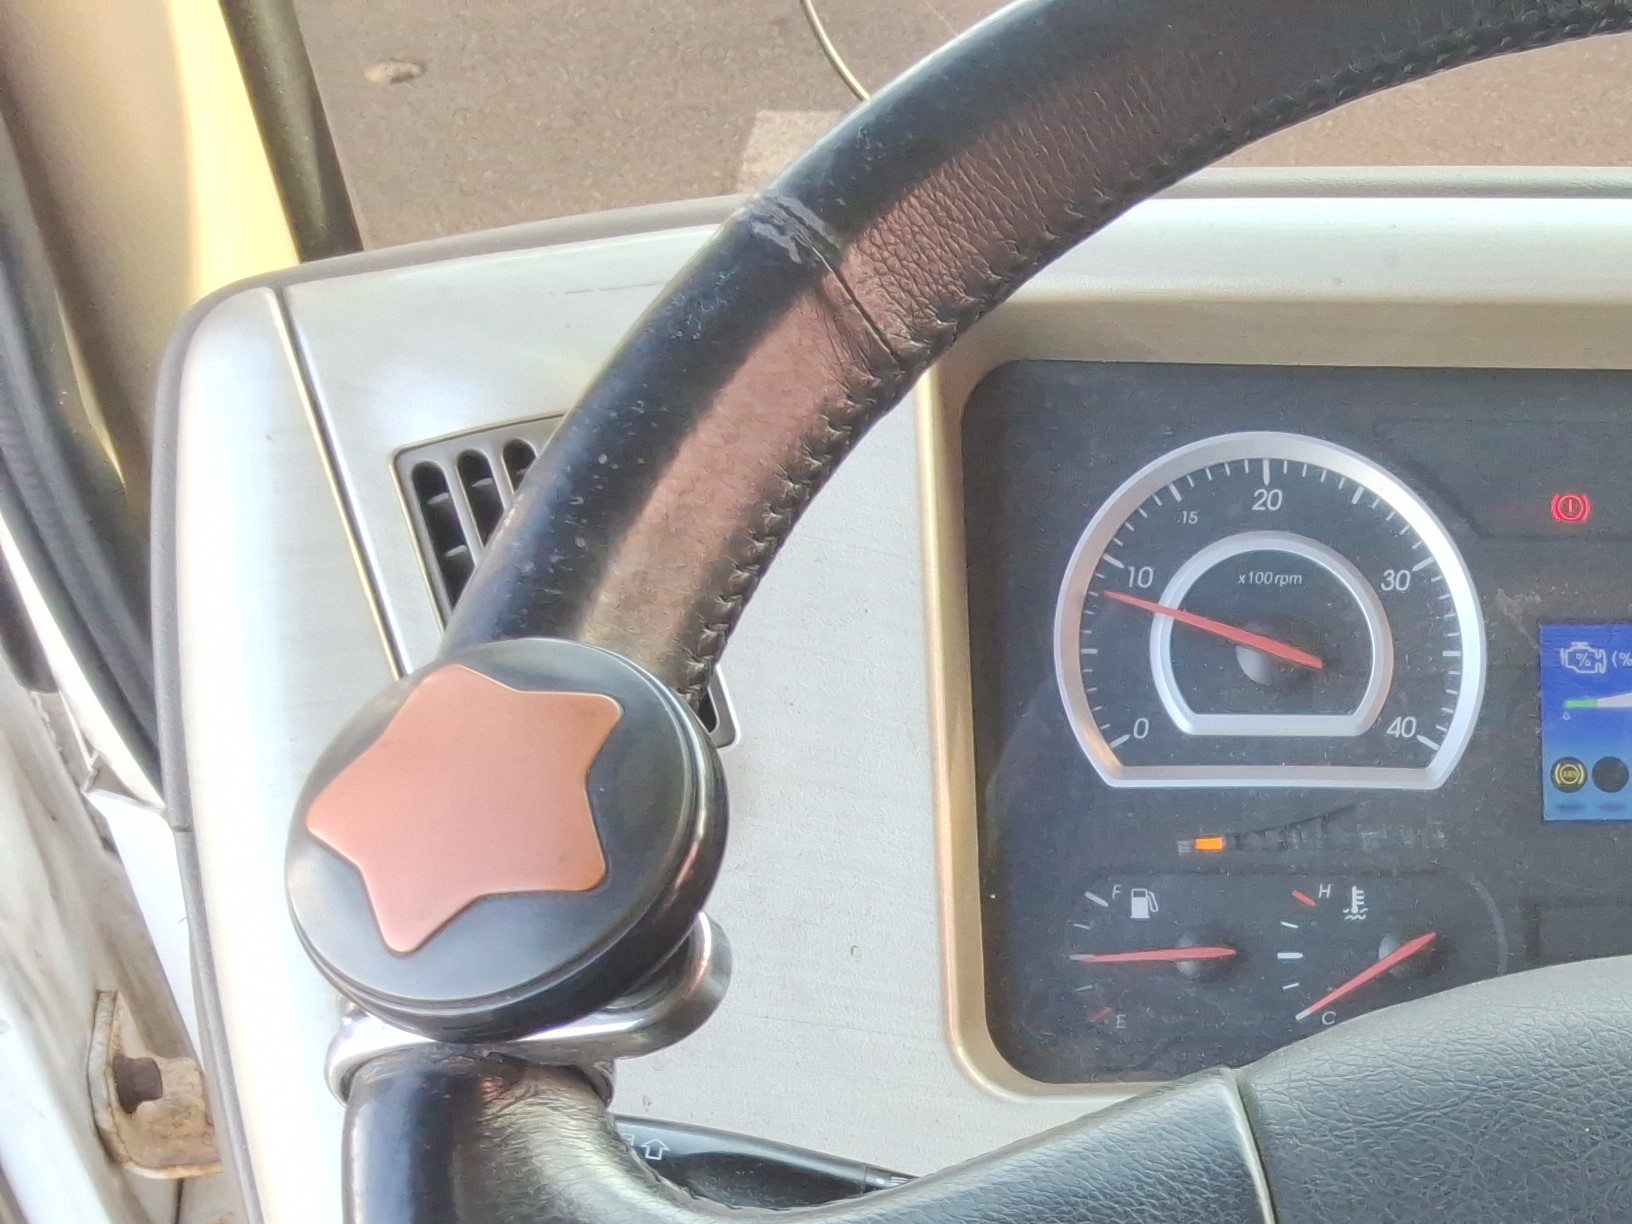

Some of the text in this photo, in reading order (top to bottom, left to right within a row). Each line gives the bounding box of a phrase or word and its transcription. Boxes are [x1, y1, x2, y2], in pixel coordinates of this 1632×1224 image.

[1252, 488, 1283, 511] 20
[1126, 566, 1154, 589] 10
[1380, 569, 1411, 592] 30
[1132, 717, 1149, 739] 0
[1386, 716, 1418, 739] 40
[1111, 884, 1122, 900] F
[1318, 882, 1333, 899] H
[1116, 1013, 1127, 1029] E
[1321, 1010, 1336, 1026] C
